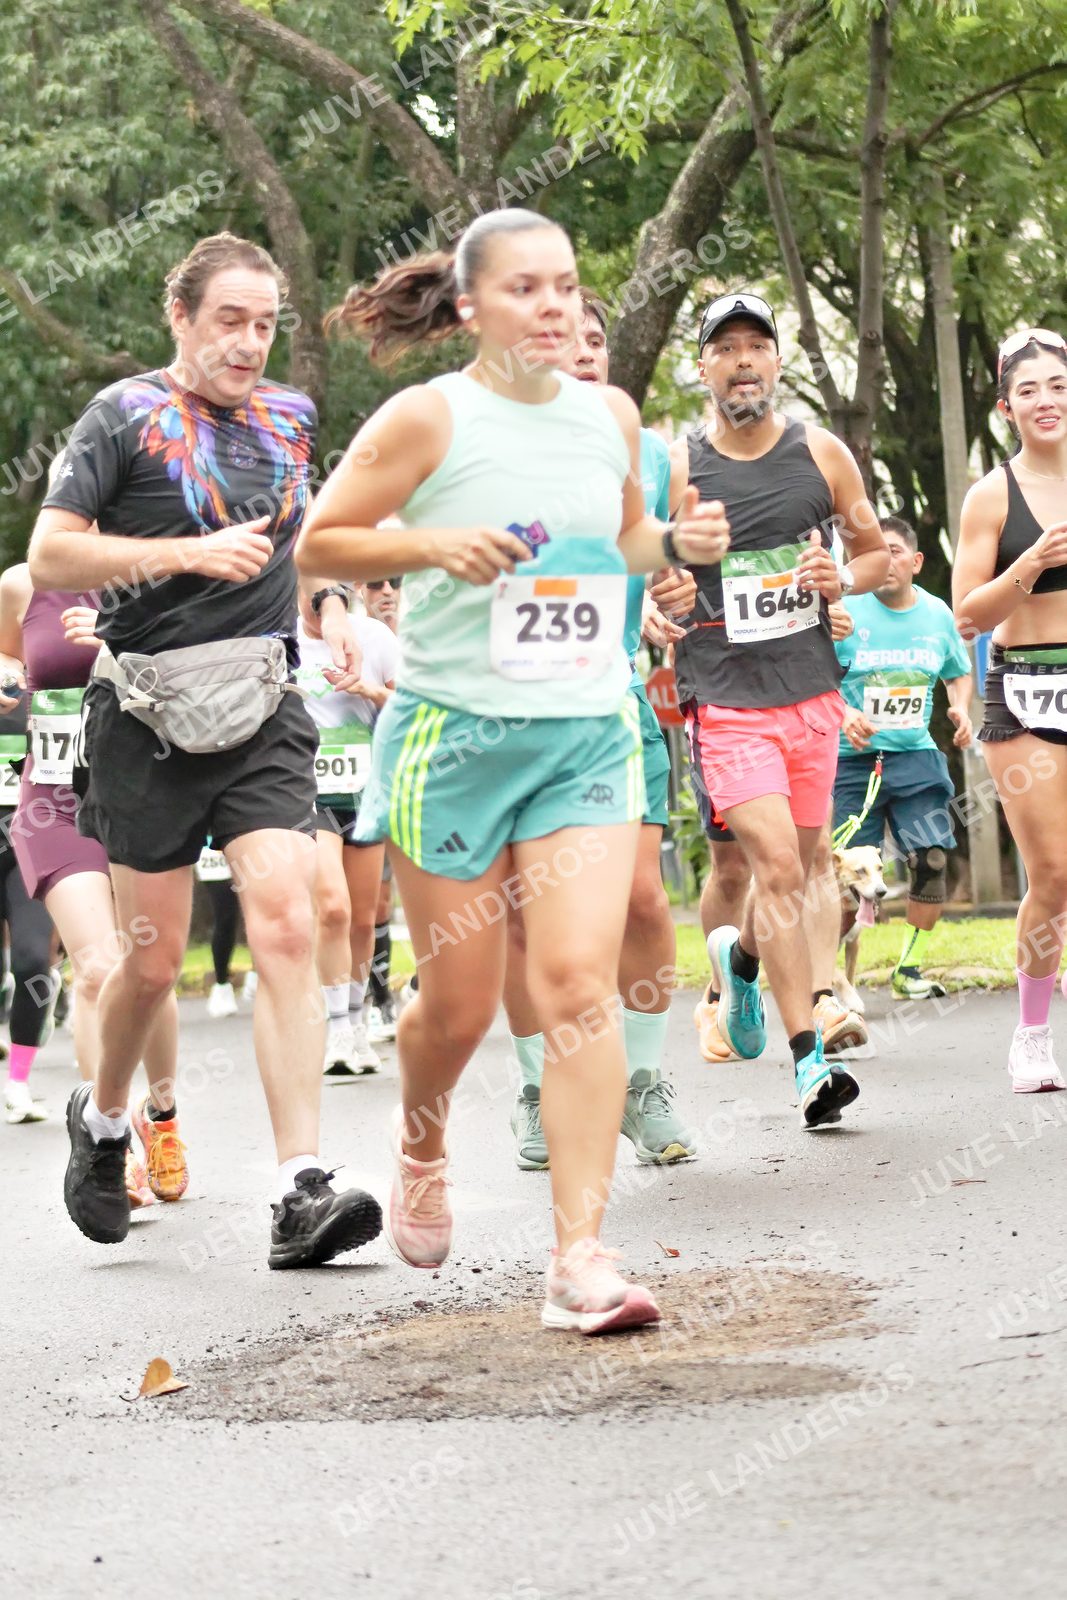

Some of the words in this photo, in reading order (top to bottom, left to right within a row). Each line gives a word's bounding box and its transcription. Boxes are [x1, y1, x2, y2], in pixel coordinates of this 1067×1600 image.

[734, 583, 814, 621] 1648
[516, 602, 600, 644] 239
[871, 698, 922, 716] 1479
[315, 757, 357, 777] 901
